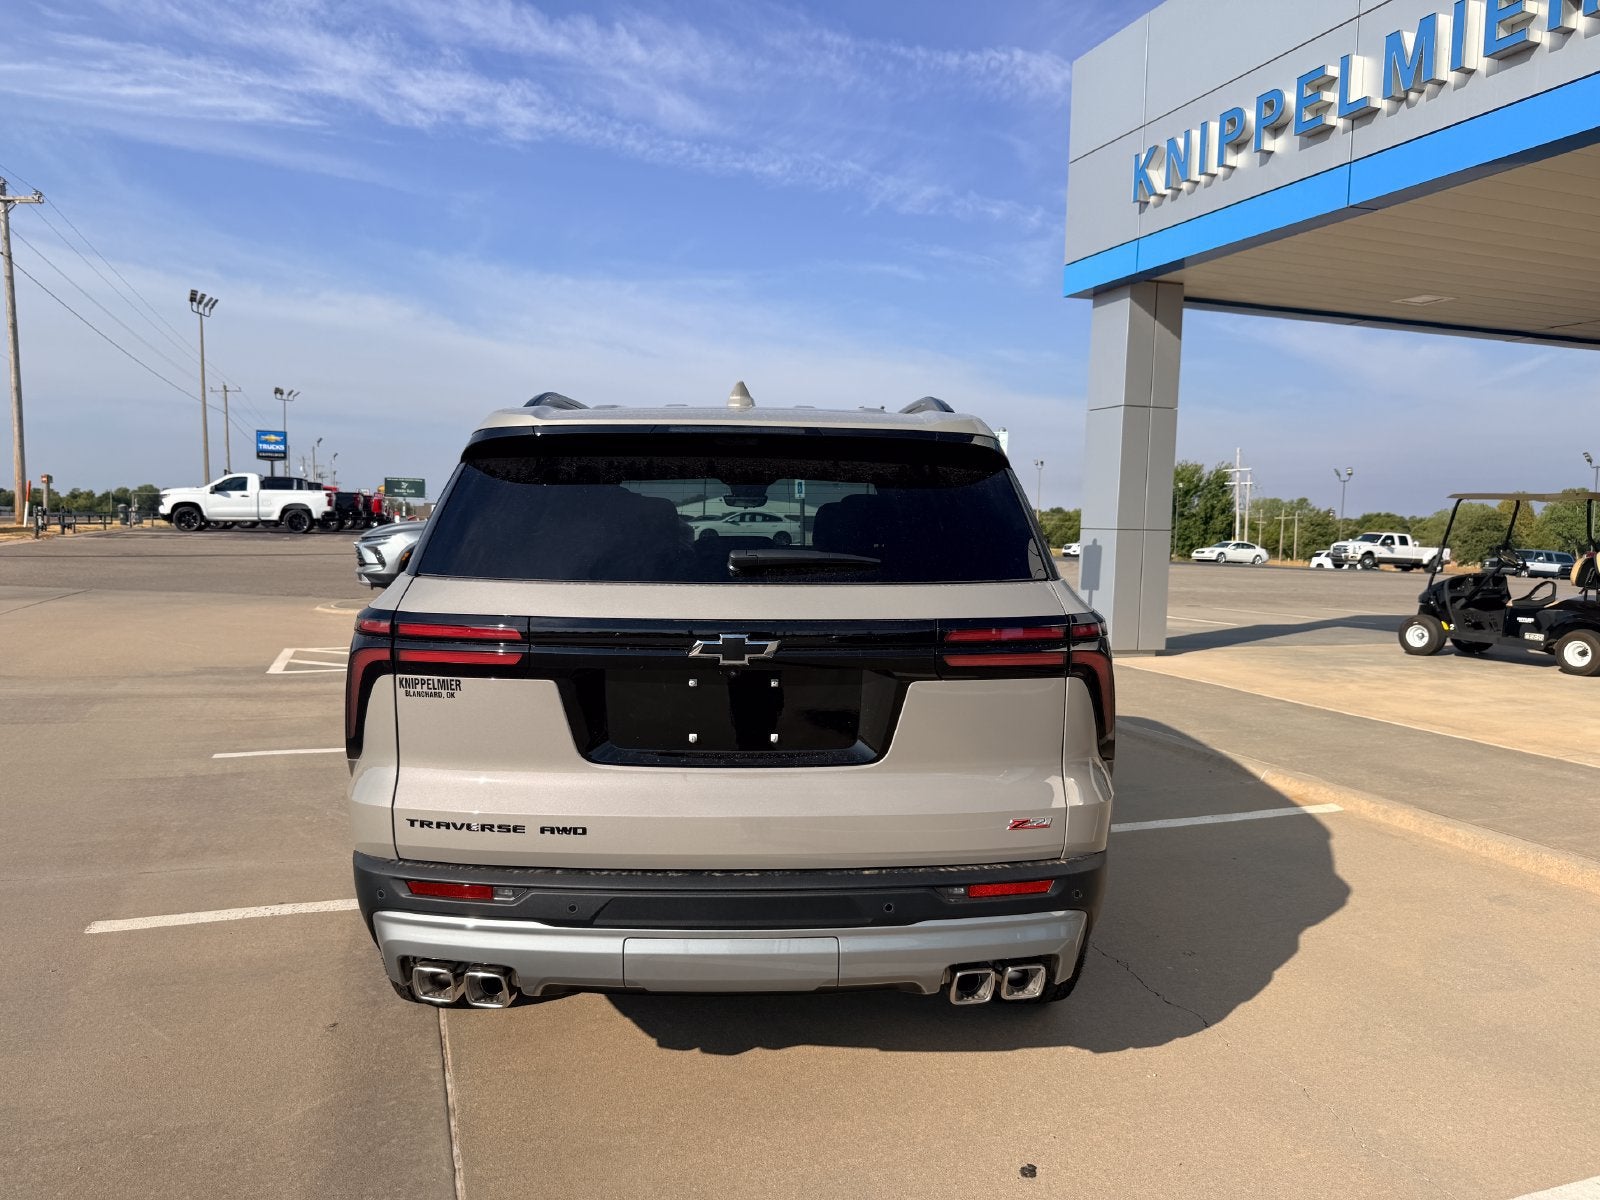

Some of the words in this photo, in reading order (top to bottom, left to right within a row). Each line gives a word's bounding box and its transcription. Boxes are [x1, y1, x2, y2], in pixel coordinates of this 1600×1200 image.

[258, 443, 285, 451] TRUCKS
[398, 677, 462, 692] KNIPPELMIER
[405, 690, 445, 699] BLANCHARD,
[446, 691, 456, 699] OK
[405, 818, 526, 834] TRAVERSE
[539, 826, 588, 836] AWD
